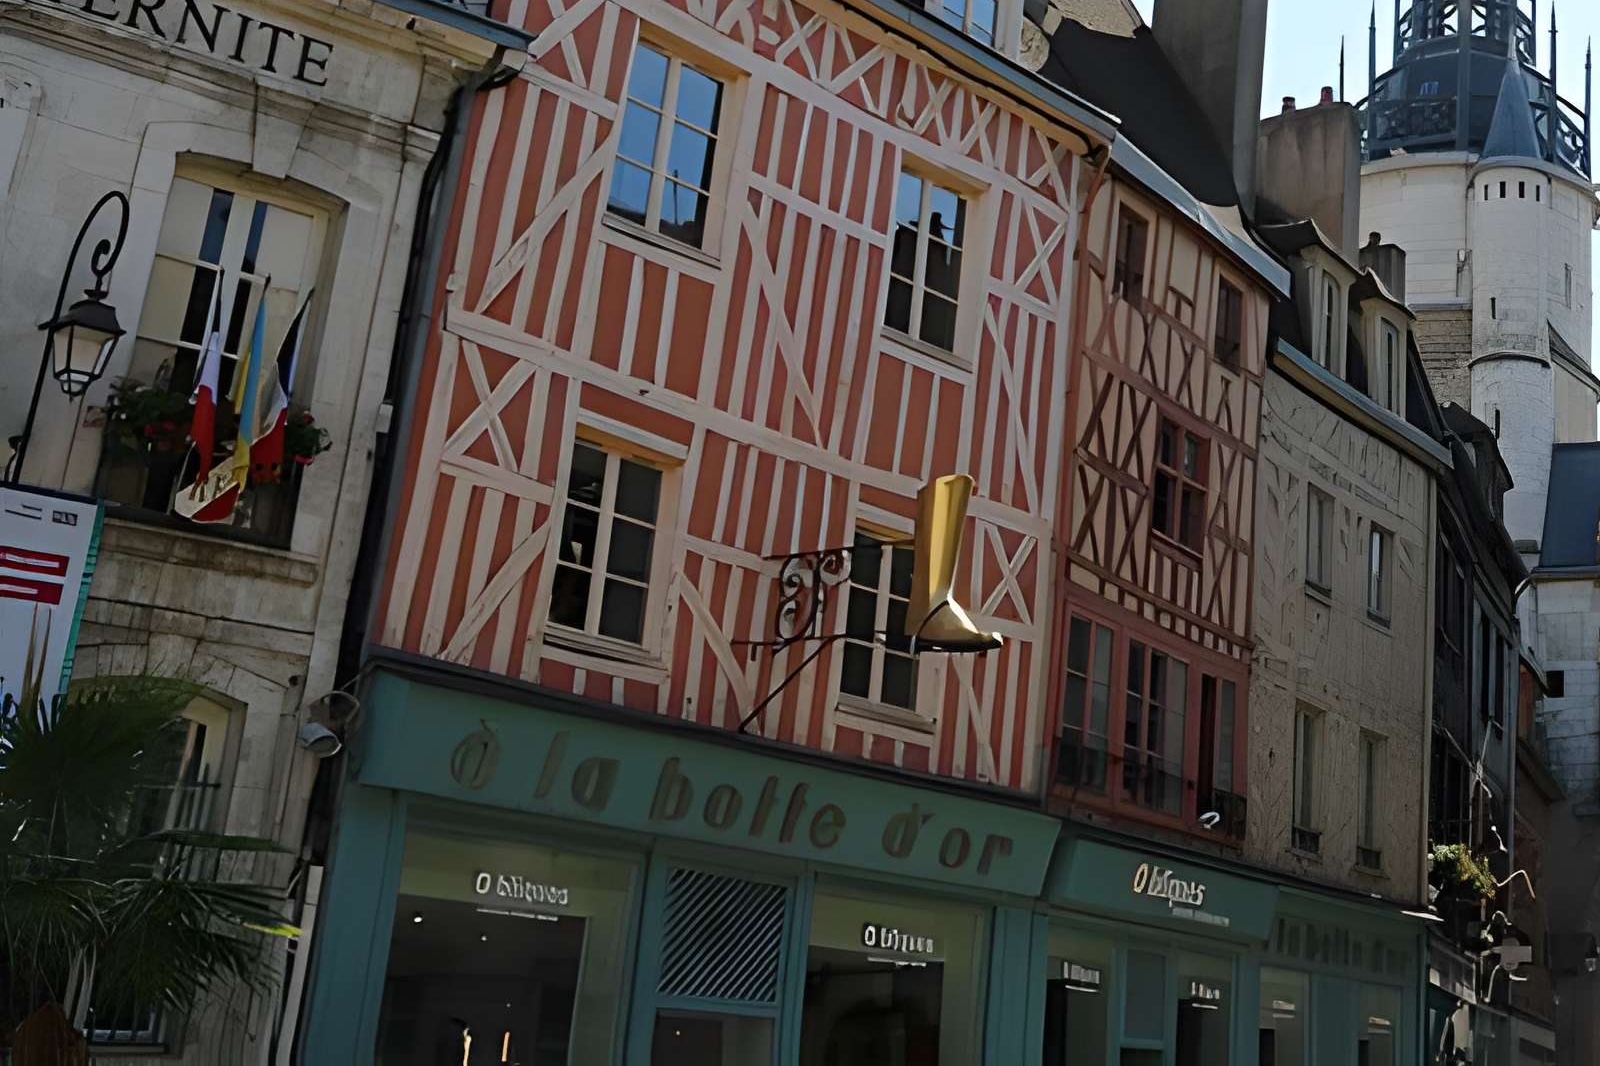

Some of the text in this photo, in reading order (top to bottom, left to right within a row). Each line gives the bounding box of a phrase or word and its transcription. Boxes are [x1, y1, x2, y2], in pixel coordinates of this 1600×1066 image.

[534, 730, 619, 811] la
[649, 757, 846, 848] botte
[882, 802, 1013, 876] d'or
